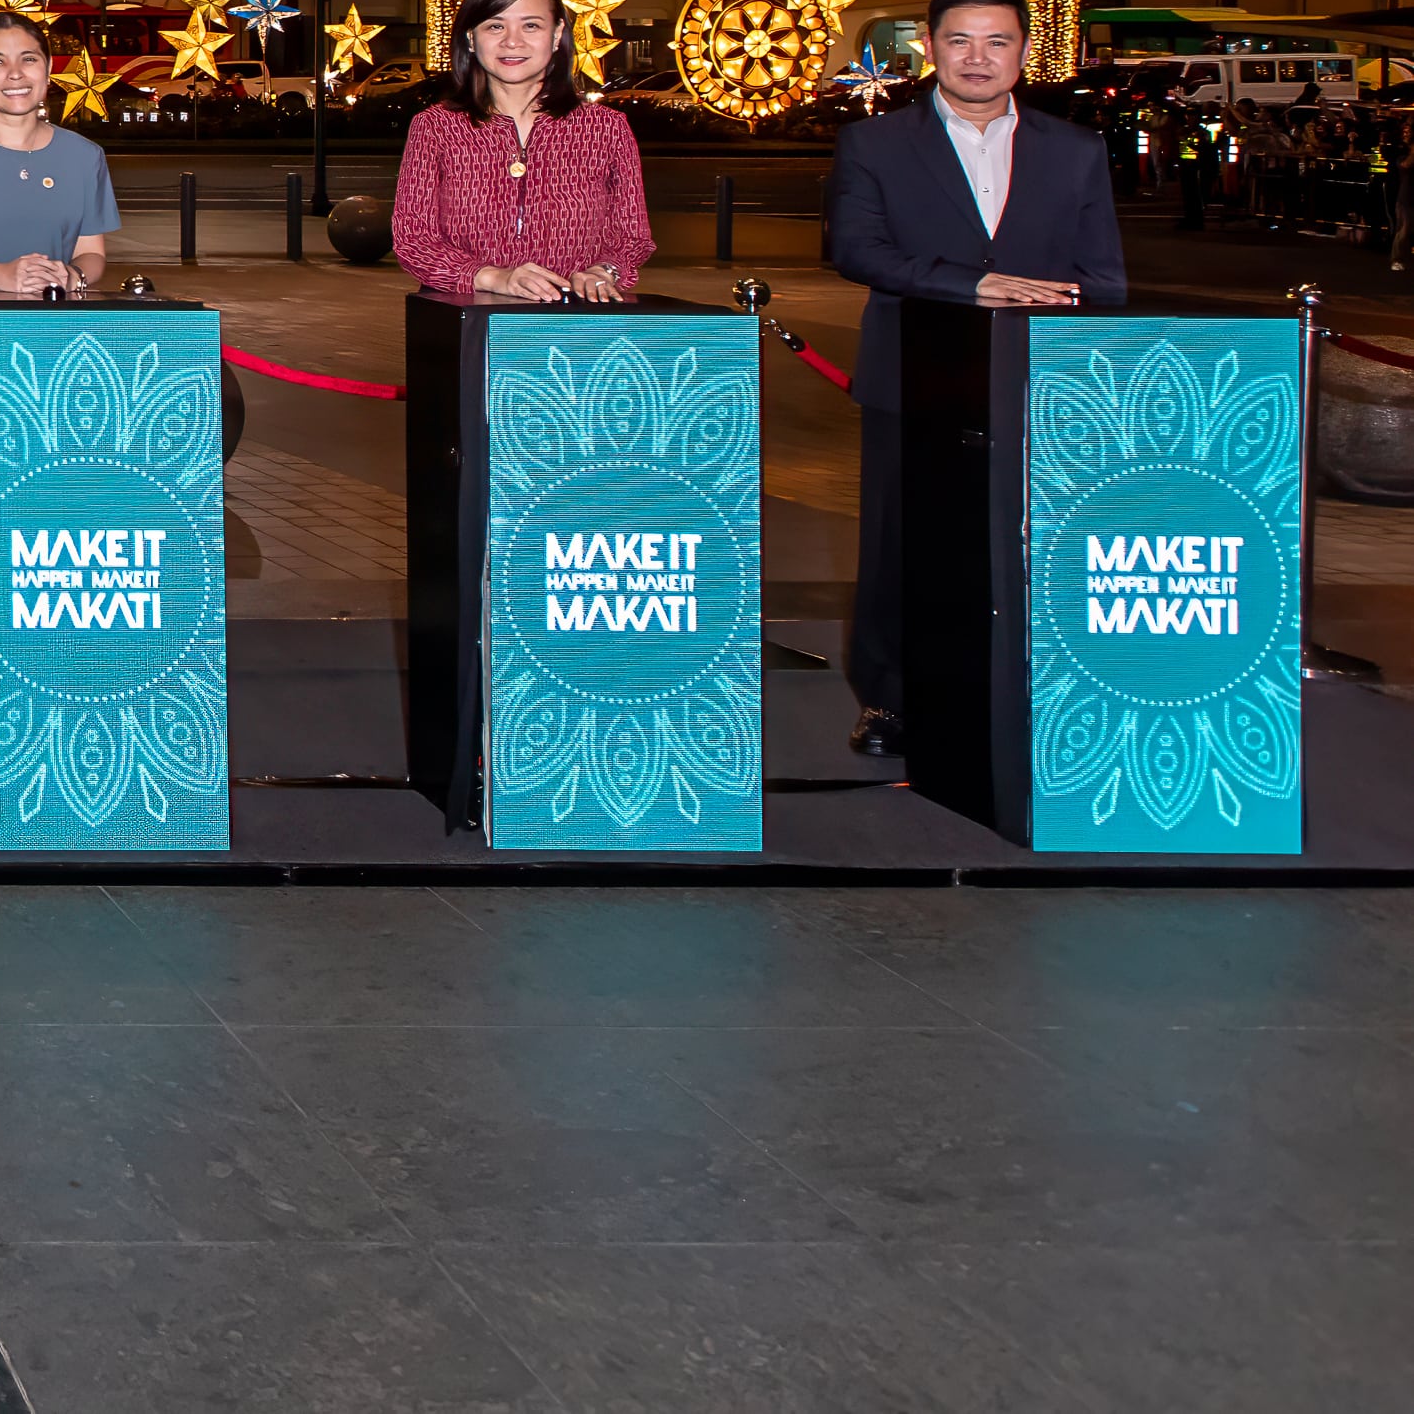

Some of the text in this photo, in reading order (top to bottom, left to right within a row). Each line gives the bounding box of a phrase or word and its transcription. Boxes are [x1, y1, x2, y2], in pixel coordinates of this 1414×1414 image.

[12, 570, 83, 588] HAPPEN
[547, 573, 618, 591] HAPPEN
[1089, 576, 1159, 593] HAPPEN
[11, 592, 162, 629] MAKATI
[546, 595, 698, 632] MAKATI
[1088, 598, 1239, 635] MAKATI
